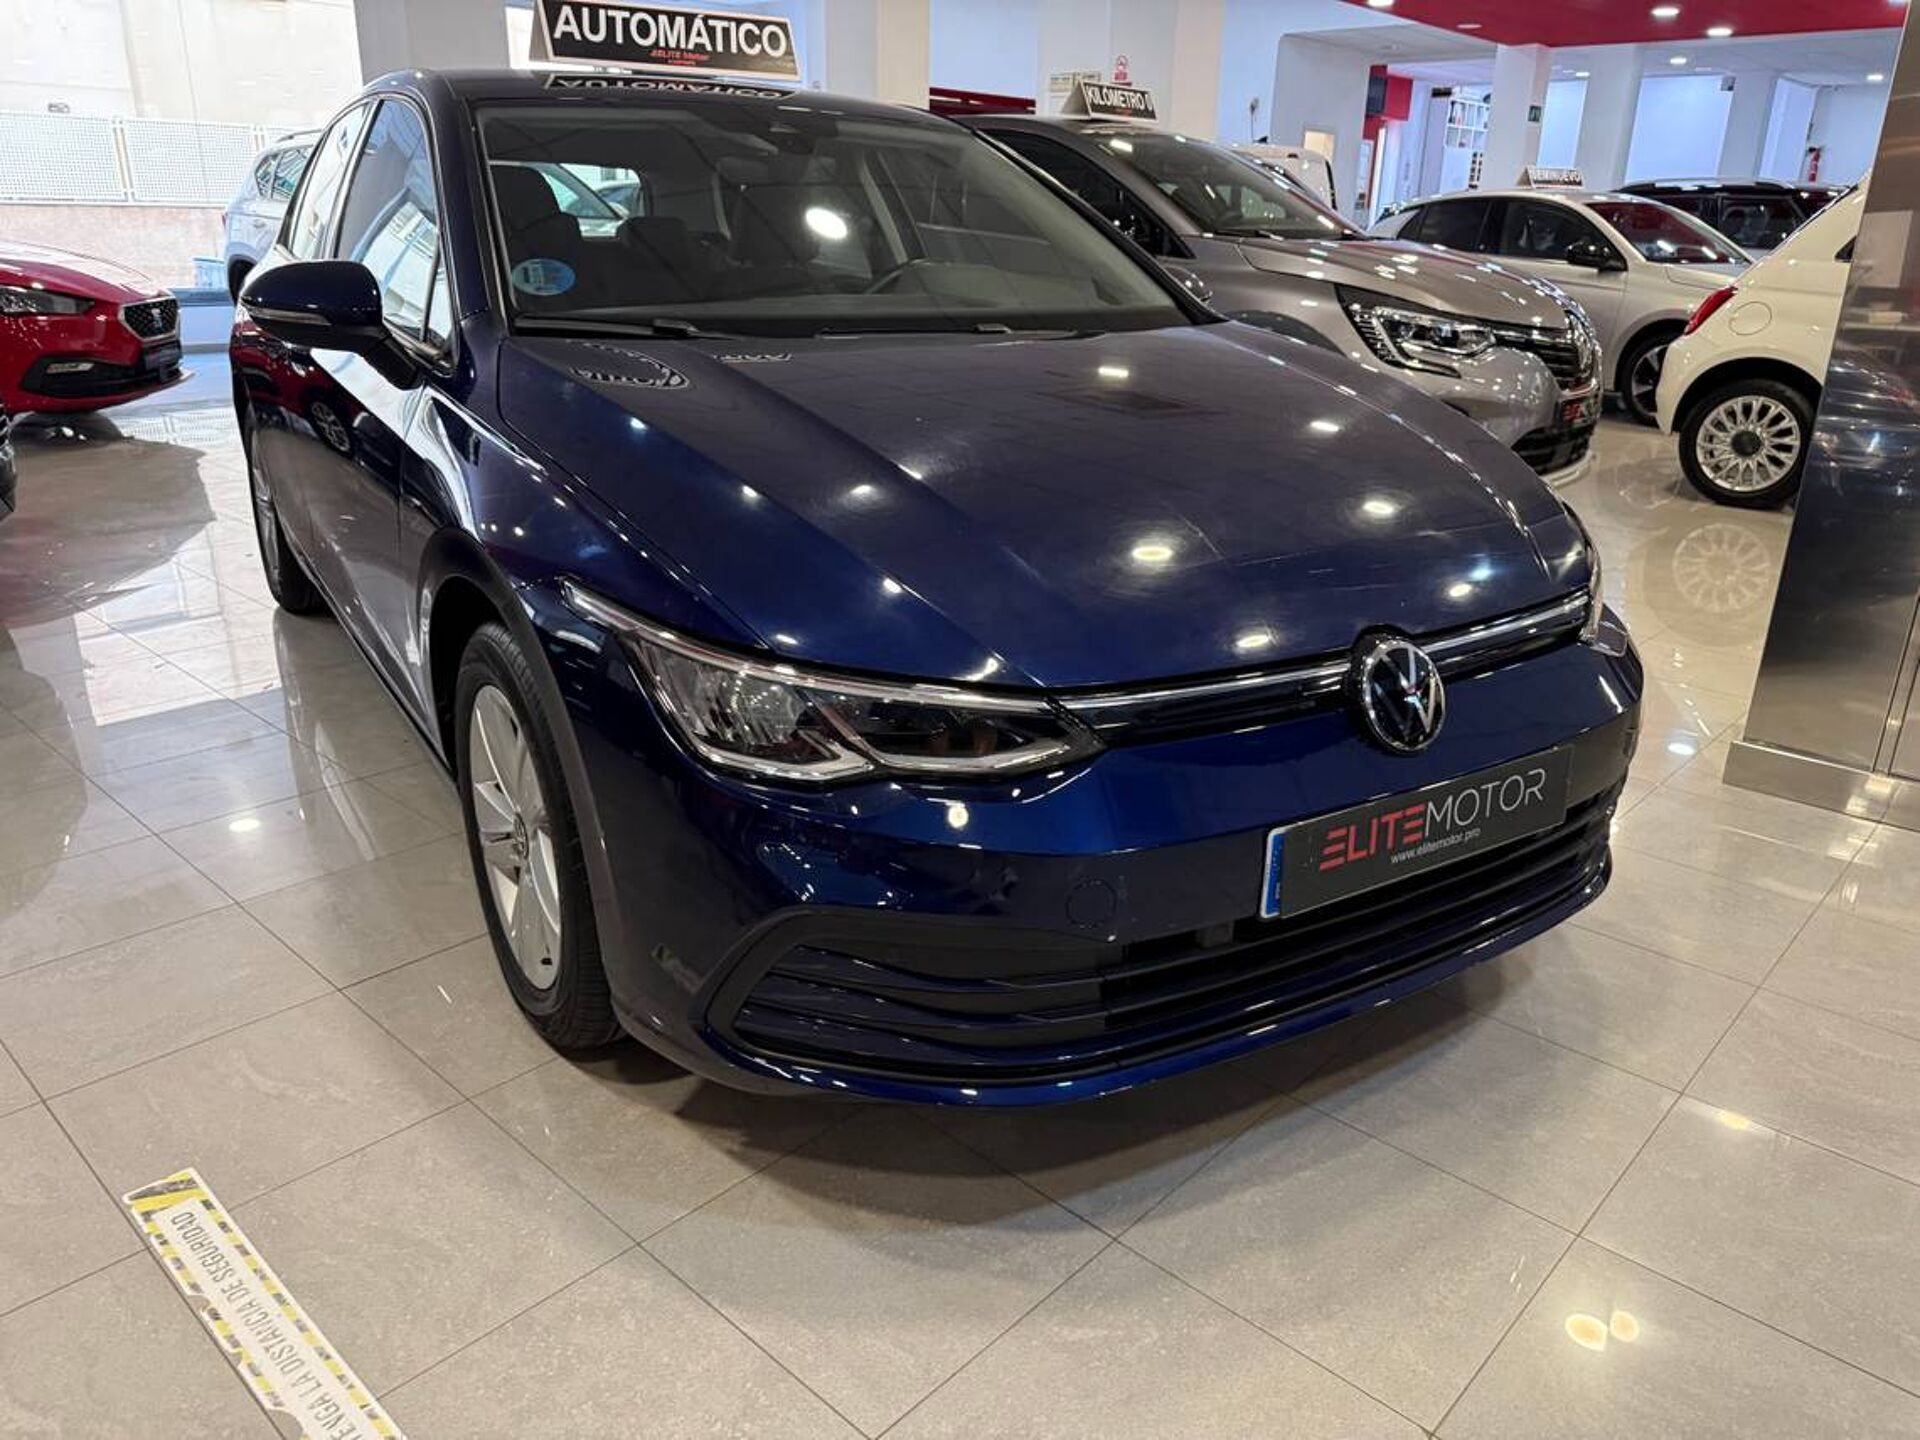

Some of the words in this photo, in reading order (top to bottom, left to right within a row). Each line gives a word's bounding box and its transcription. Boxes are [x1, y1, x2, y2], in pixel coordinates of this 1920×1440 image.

[553, 6, 787, 57] AUTOMÁTICO
[171, 1211, 235, 1283] SEGURIDAD
[221, 1277, 247, 1307] DE
[237, 1298, 305, 1374] DISTANCIA
[291, 1370, 322, 1397] LA
